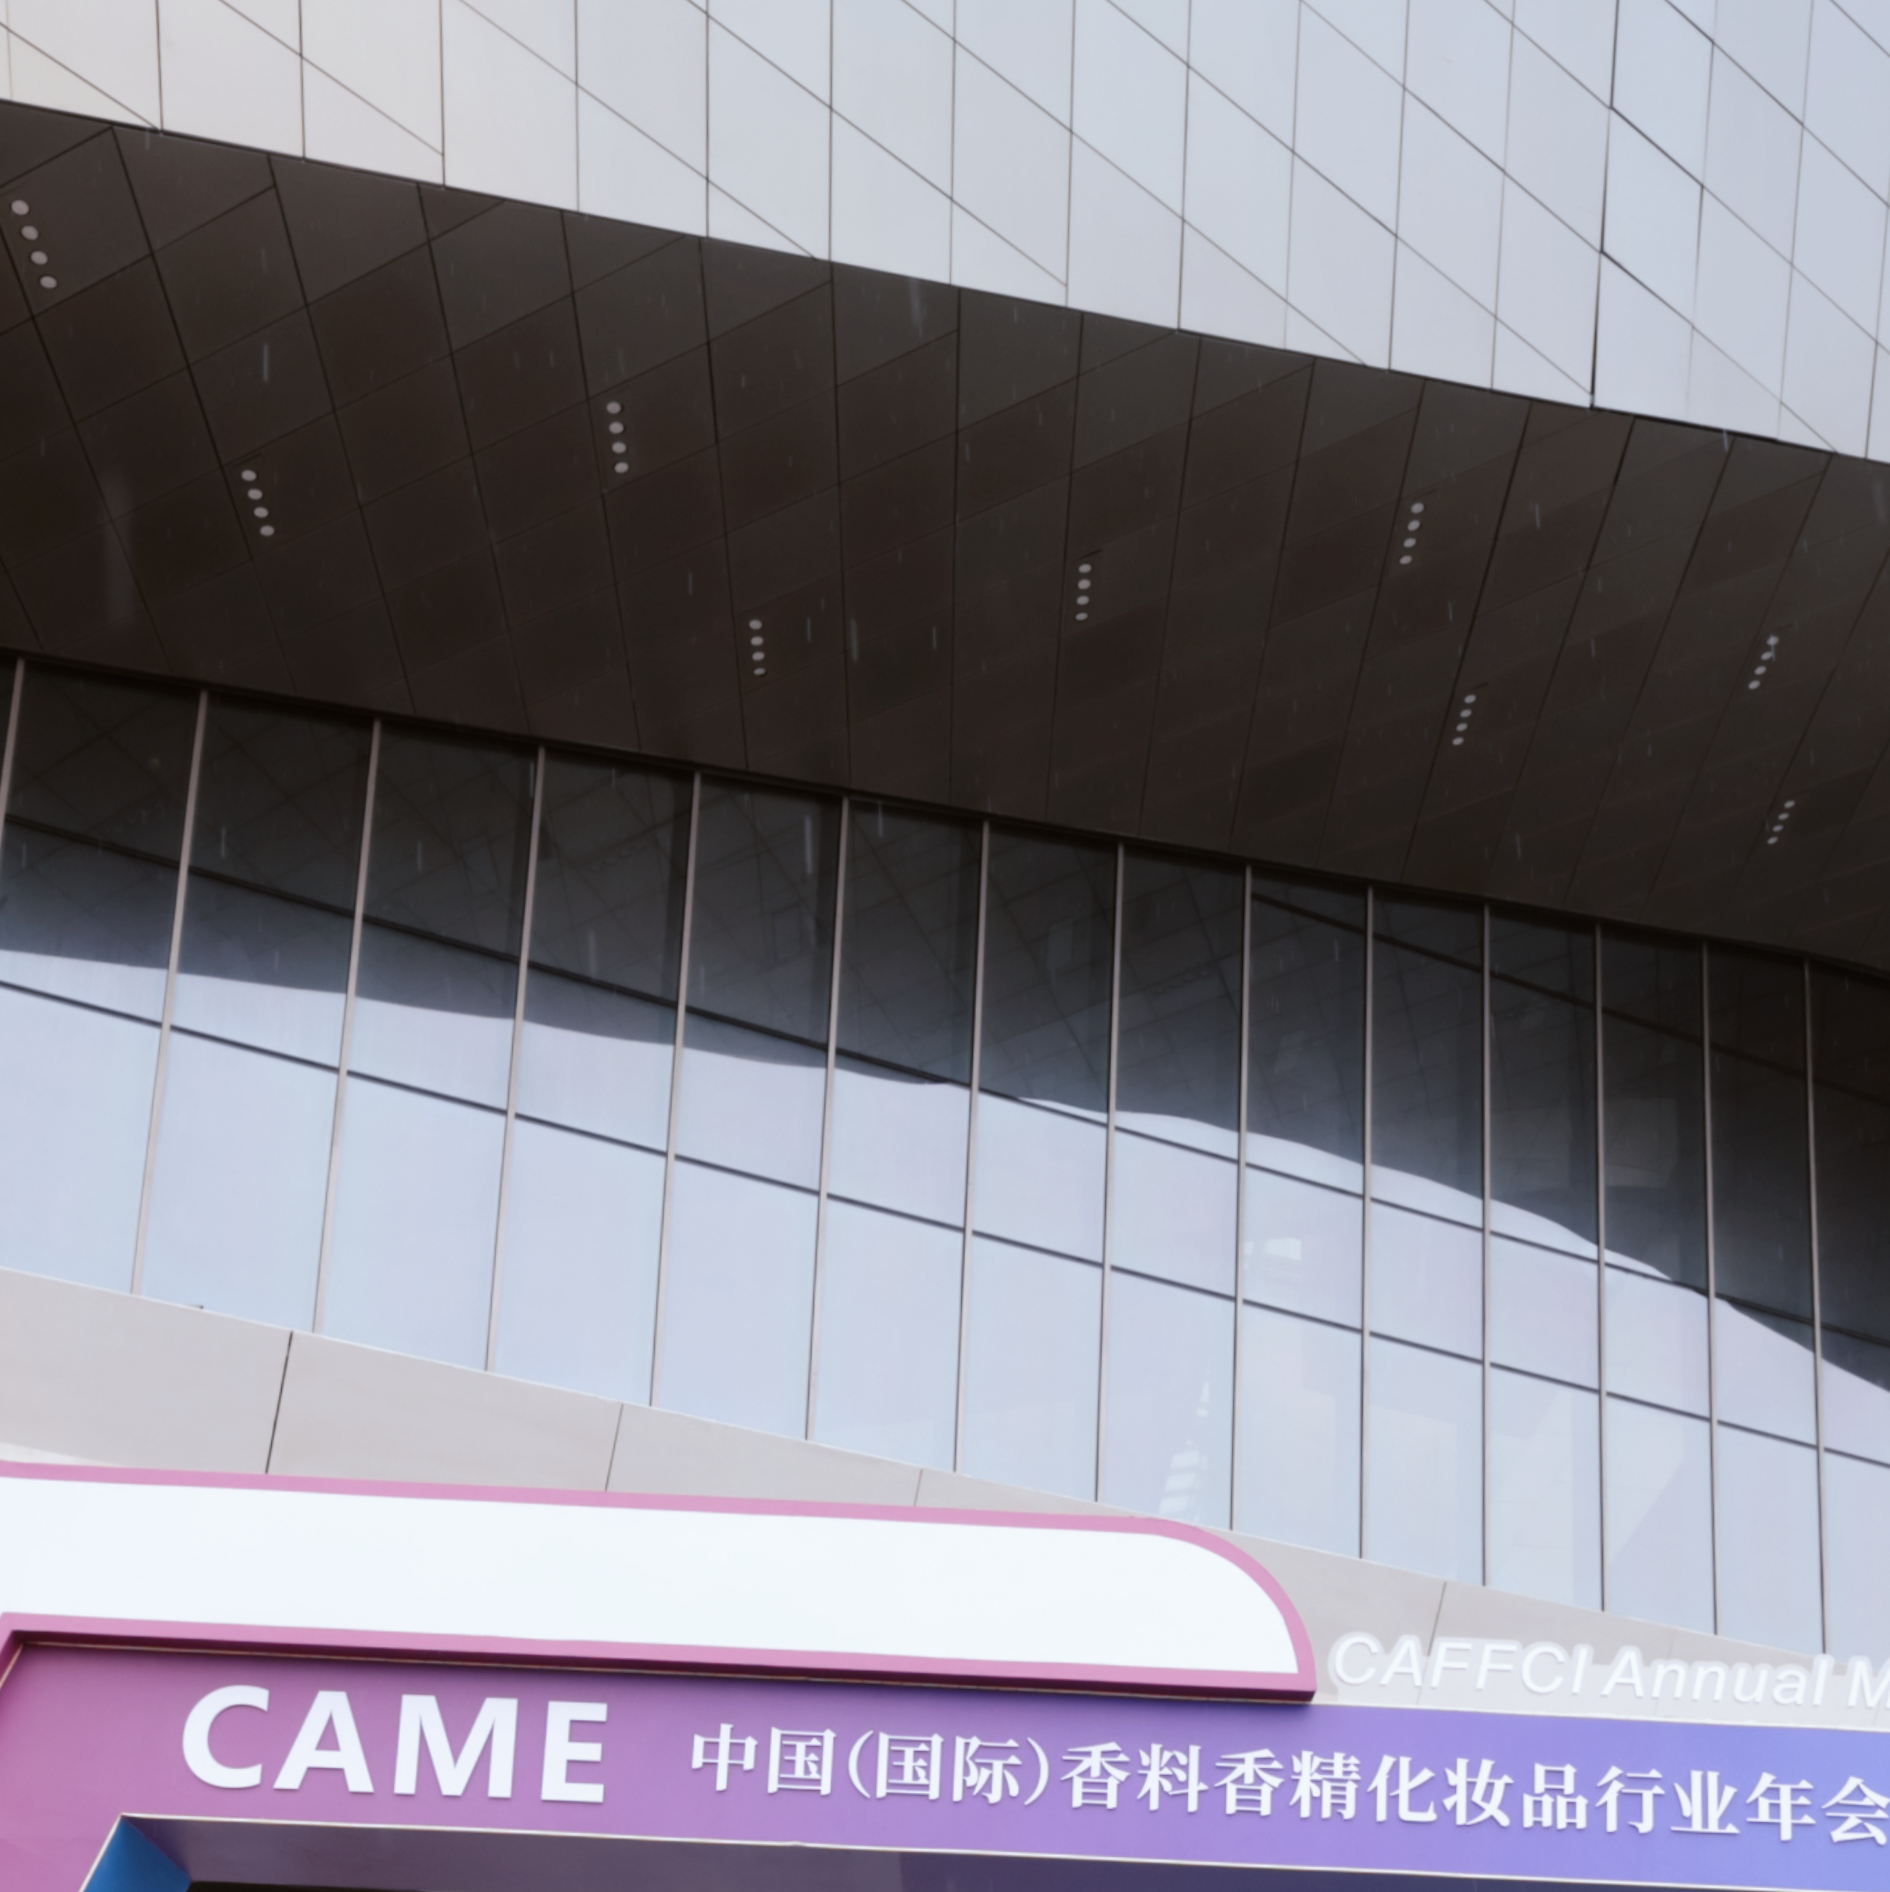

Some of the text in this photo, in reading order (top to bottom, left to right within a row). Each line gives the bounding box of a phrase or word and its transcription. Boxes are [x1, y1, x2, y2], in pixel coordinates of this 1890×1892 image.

[1333, 1633, 1591, 1696] CAFFCI
[1602, 1646, 1830, 1707] Annual
[181, 1684, 608, 1803] CAME
